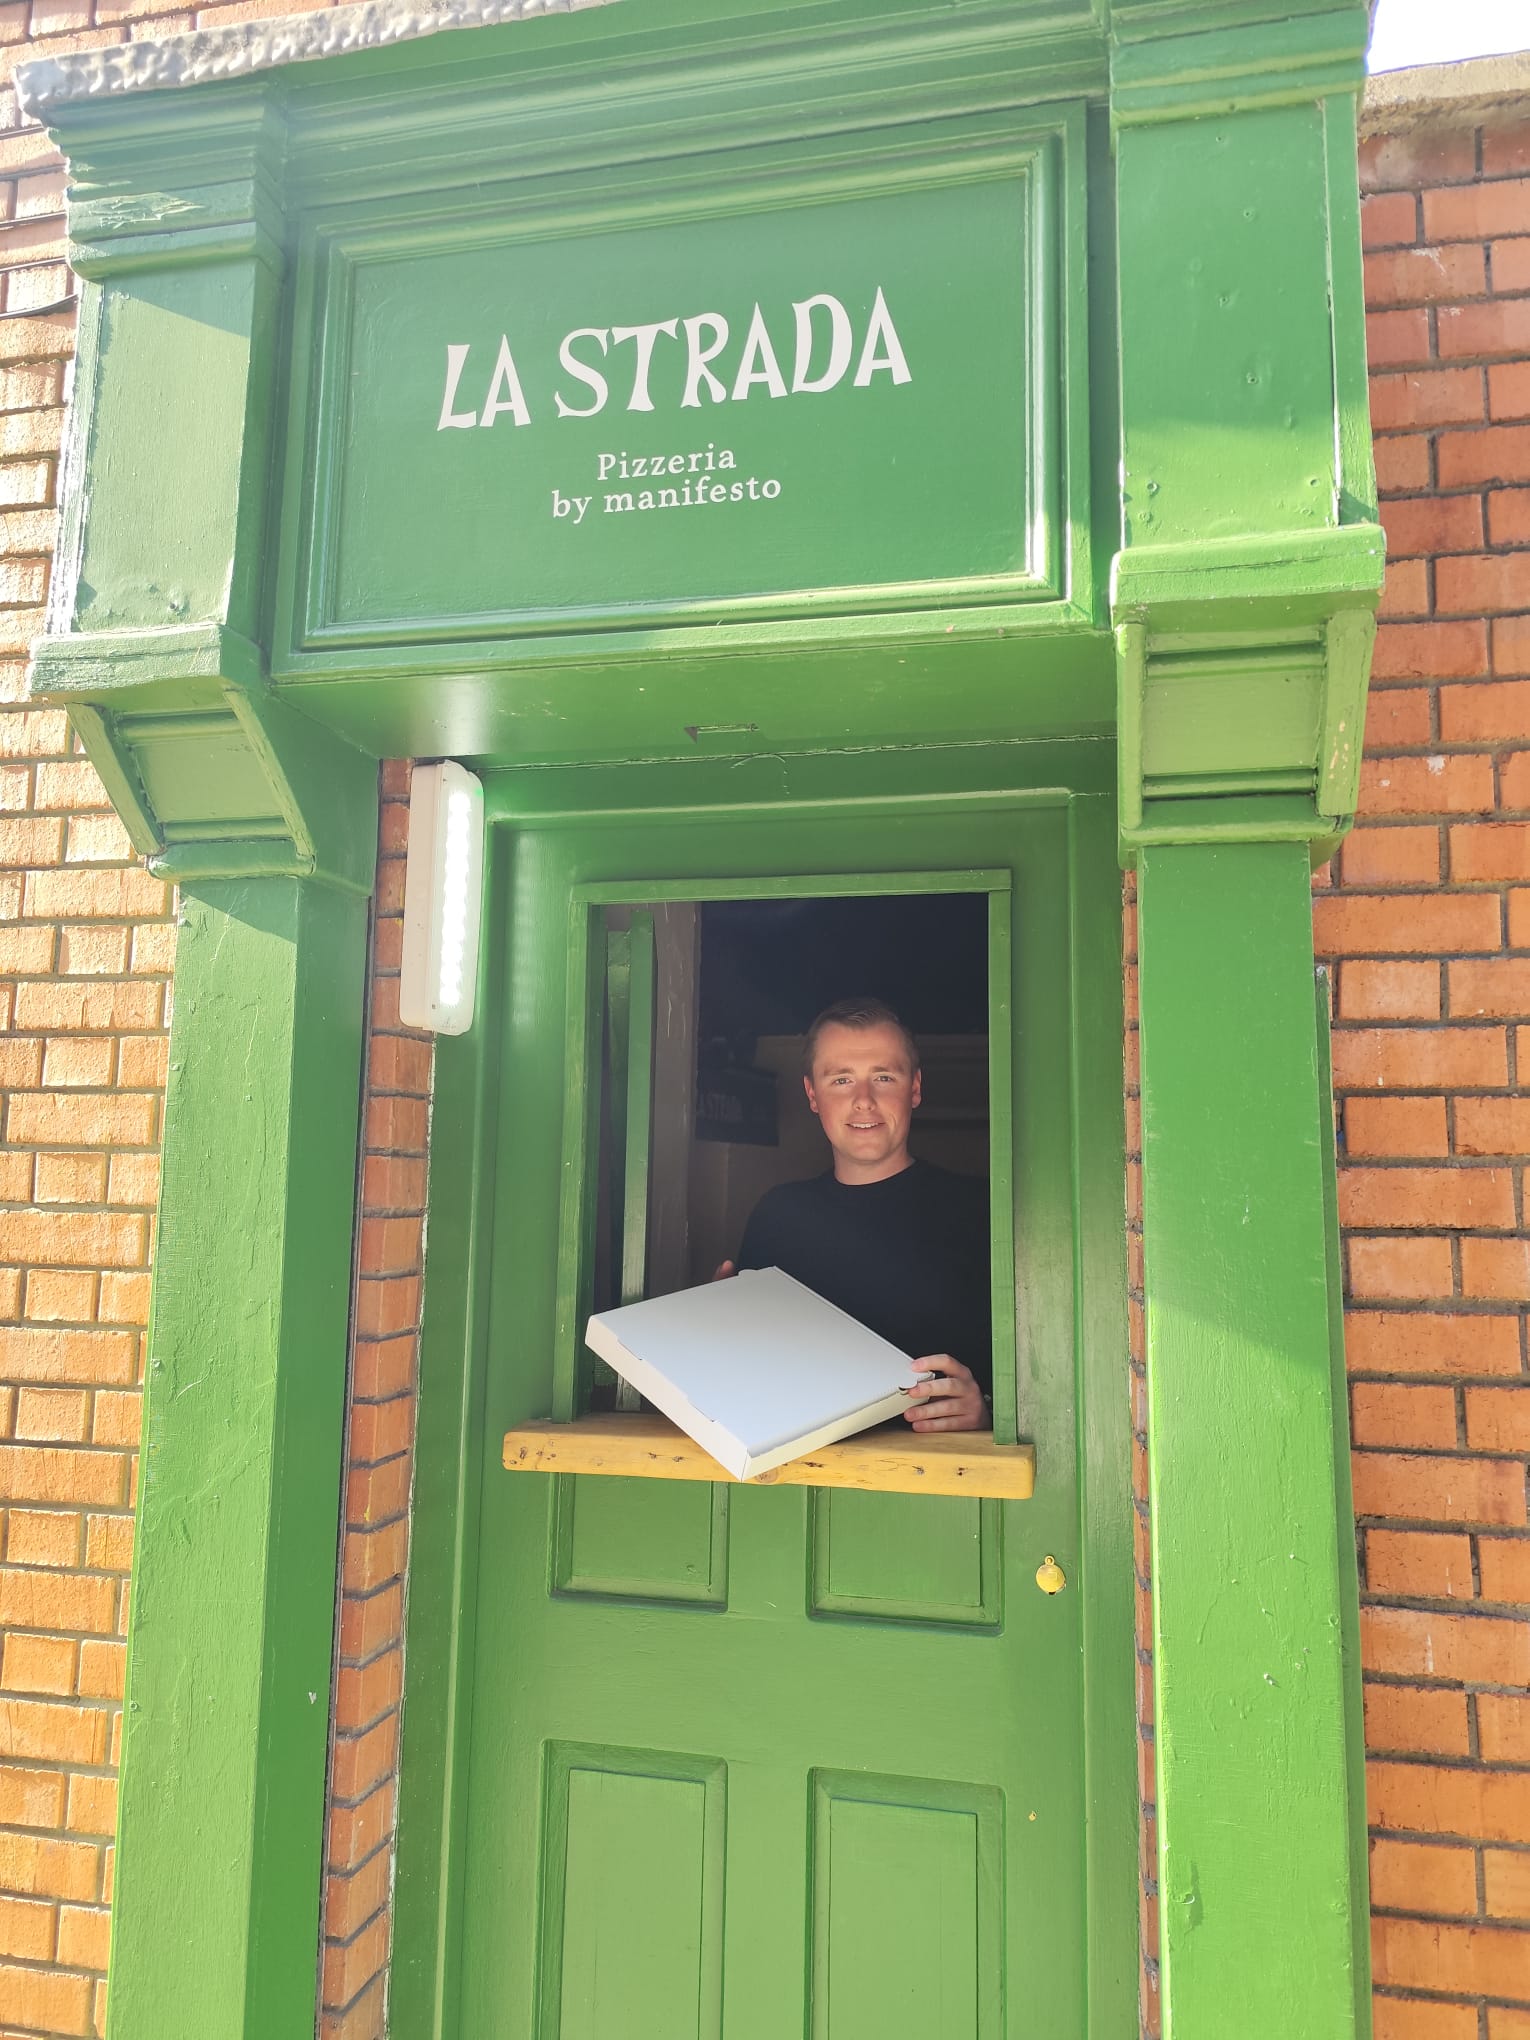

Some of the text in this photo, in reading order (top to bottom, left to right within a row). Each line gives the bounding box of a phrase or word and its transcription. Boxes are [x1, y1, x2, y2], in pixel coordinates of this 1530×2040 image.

[436, 285, 913, 432] LA STRADA
[596, 442, 737, 481] Pizzeria
[551, 475, 782, 525] by manifesto
